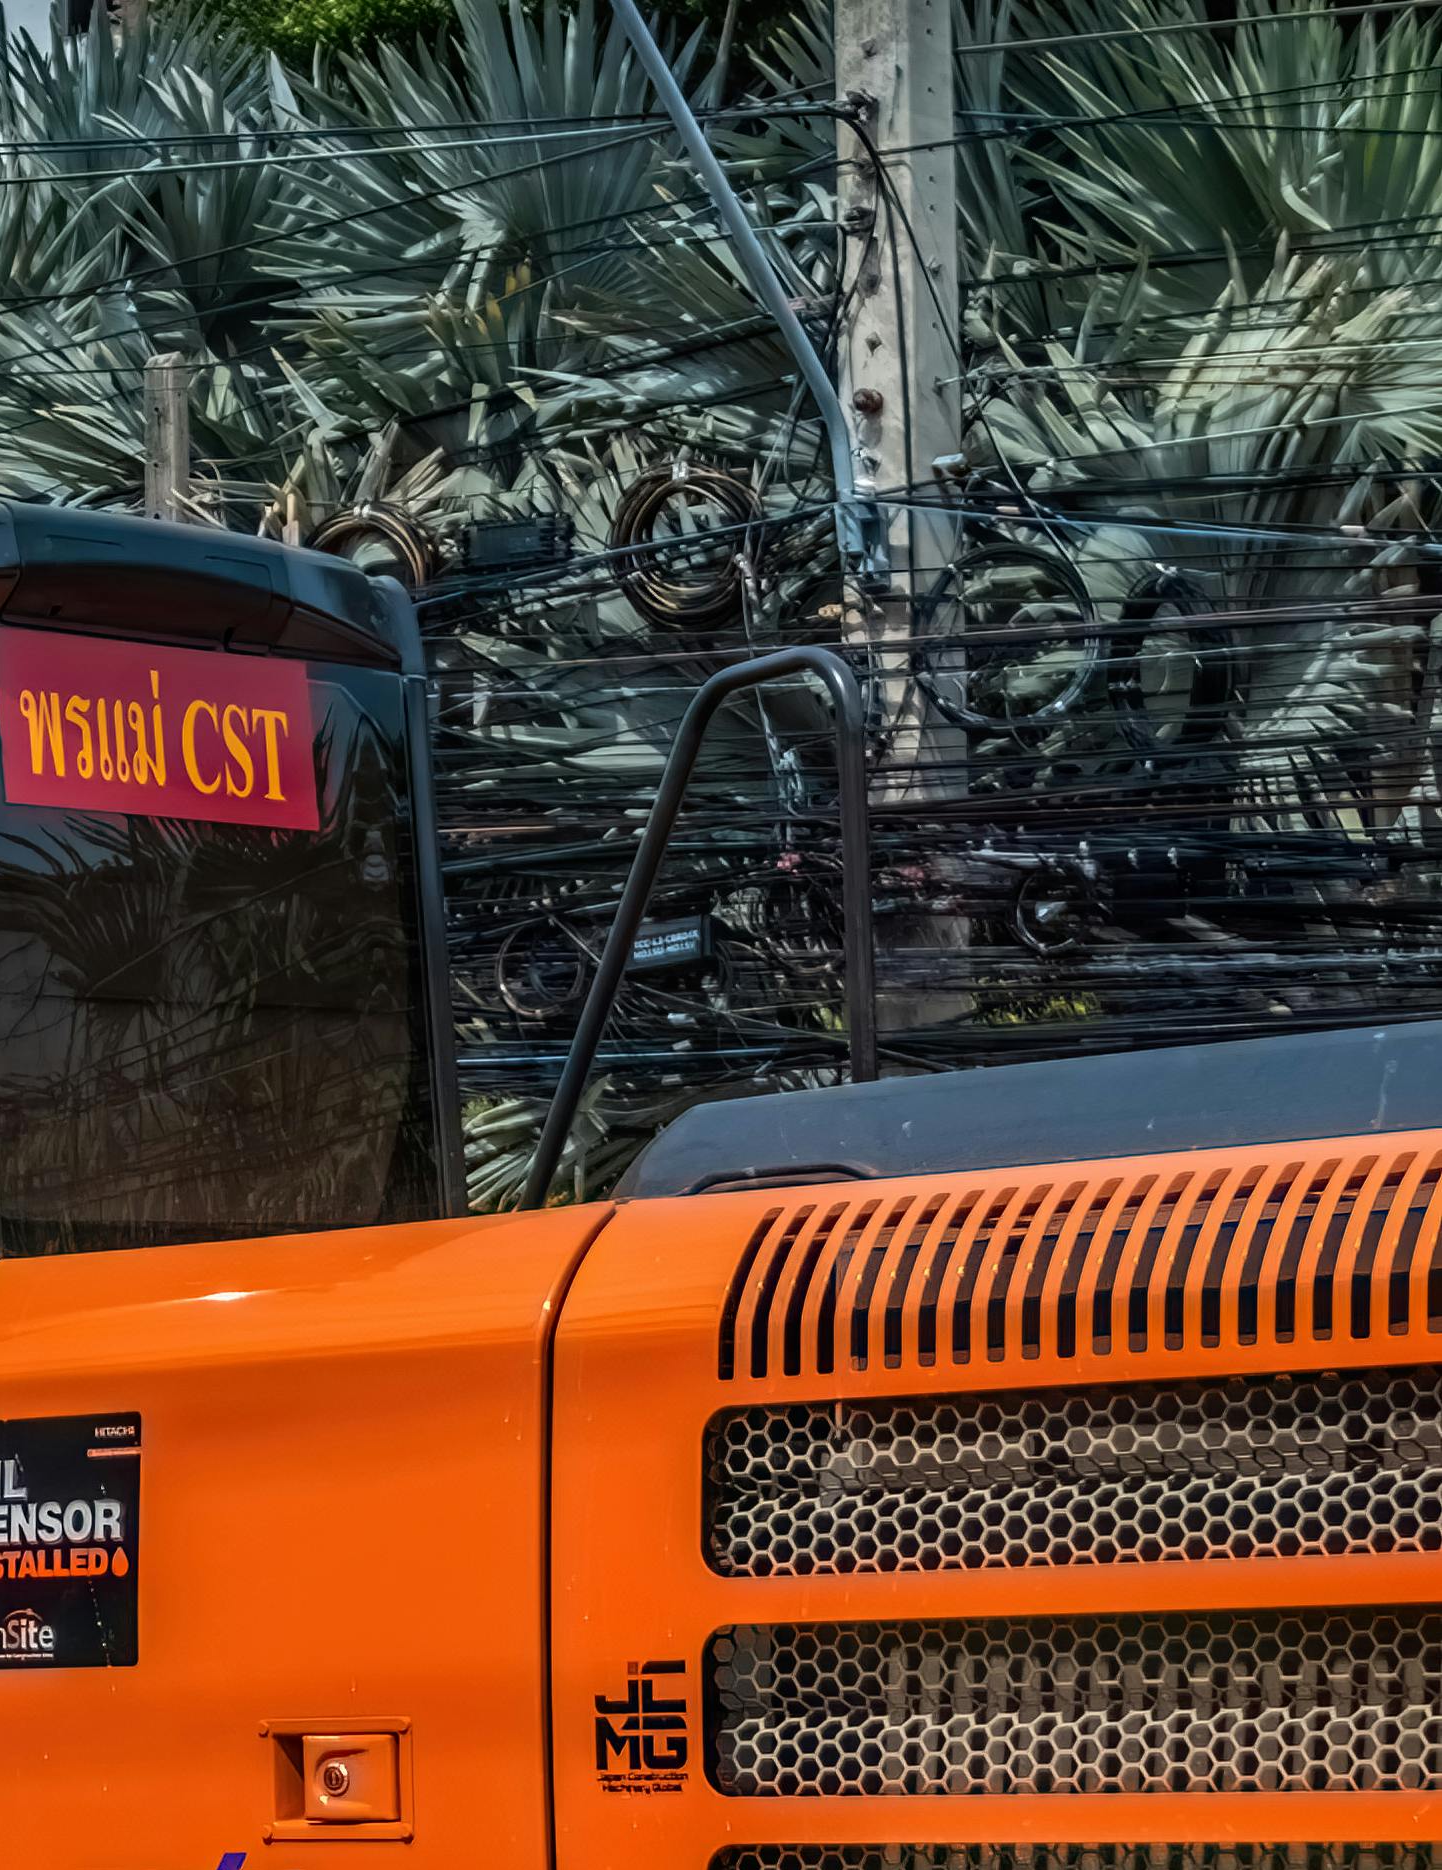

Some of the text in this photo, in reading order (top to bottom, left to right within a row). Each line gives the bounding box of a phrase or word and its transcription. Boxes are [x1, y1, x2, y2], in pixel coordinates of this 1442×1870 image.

[20, 669, 288, 801] พรแม่ CST
[94, 1425, 135, 1438] HITACHI
